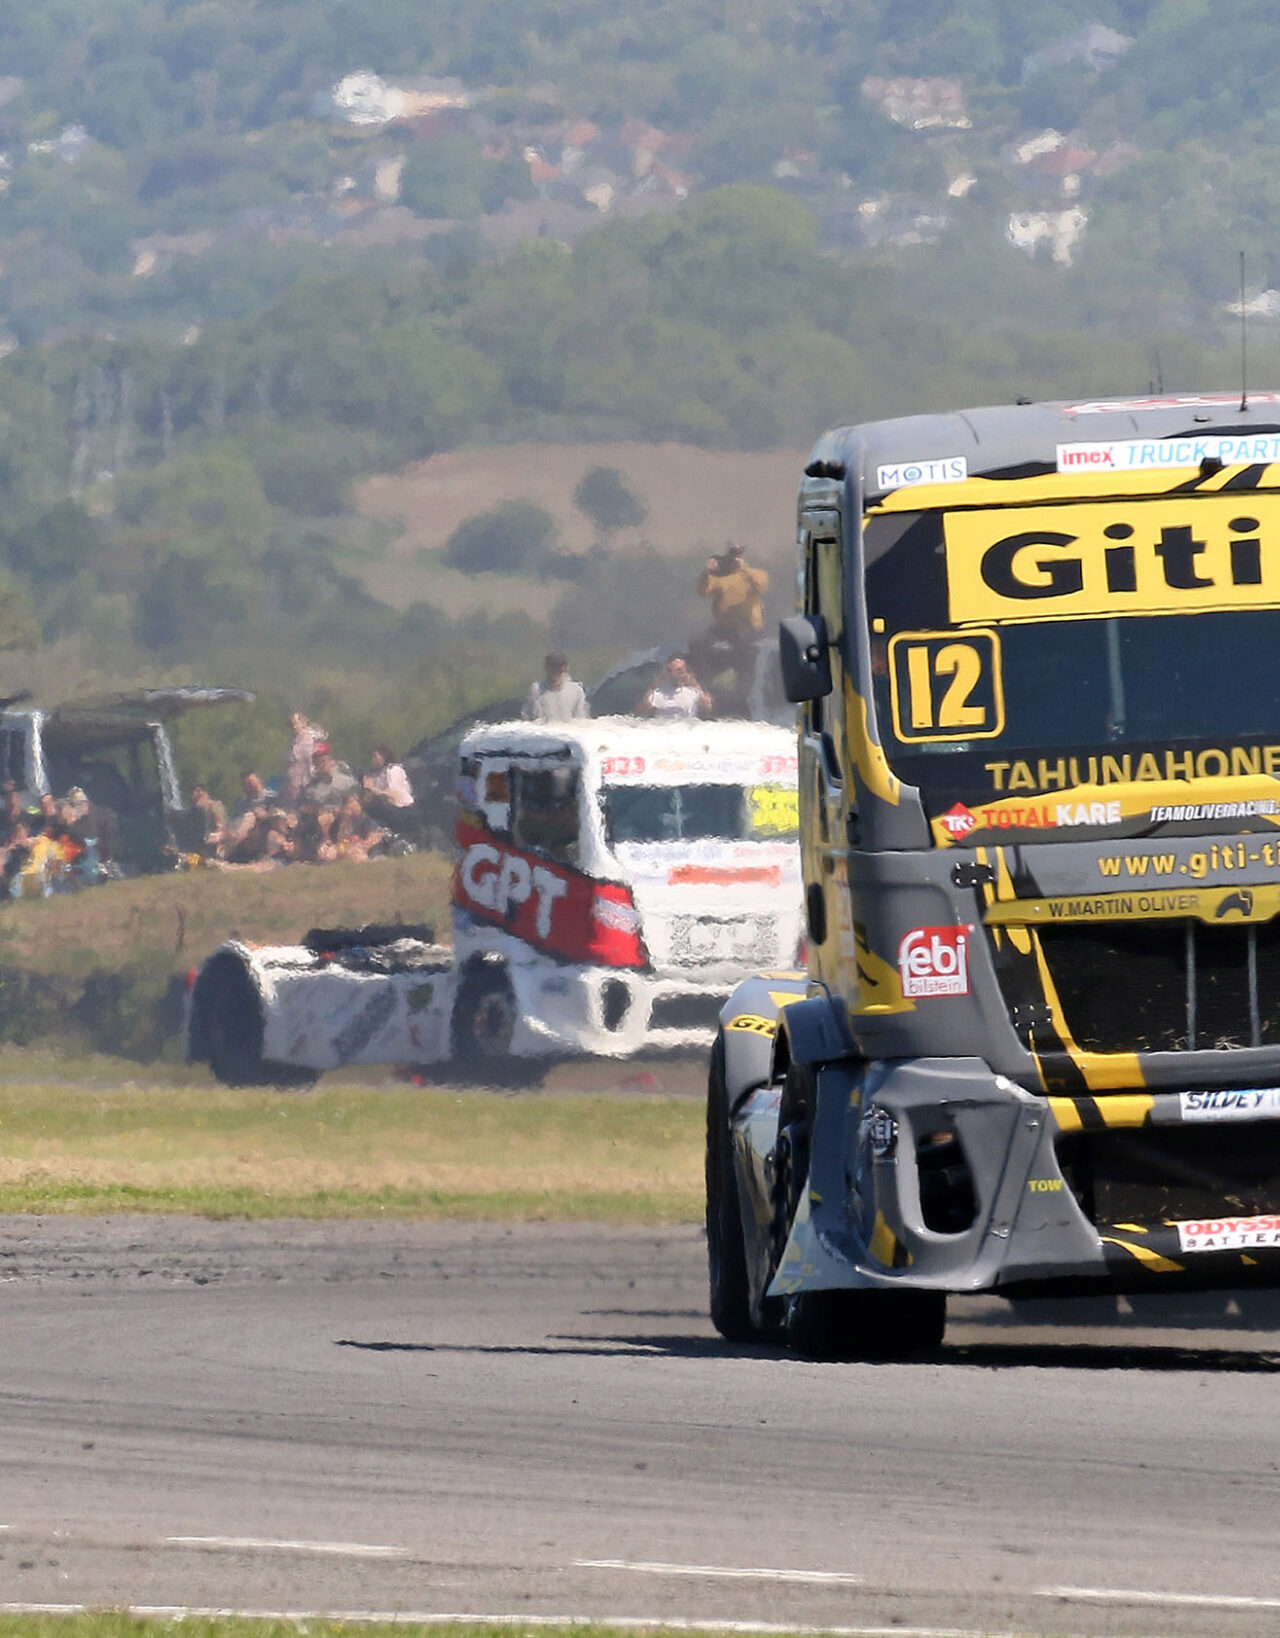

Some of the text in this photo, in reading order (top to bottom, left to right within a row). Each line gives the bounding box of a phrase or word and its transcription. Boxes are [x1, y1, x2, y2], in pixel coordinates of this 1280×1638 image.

[1063, 450, 1113, 465] imex
[1127, 443, 1208, 464] TRUCK
[881, 462, 964, 486] MOTIS
[980, 517, 1263, 600] Giti
[907, 643, 986, 730] 12
[983, 801, 1121, 829] TOTALKARE
[460, 843, 568, 938] GPT
[1050, 894, 1200, 917] W.MARTIN OLIVER
[898, 930, 967, 984] febi
[908, 978, 960, 994] bilstein
[1029, 1180, 1061, 1192] TOW
